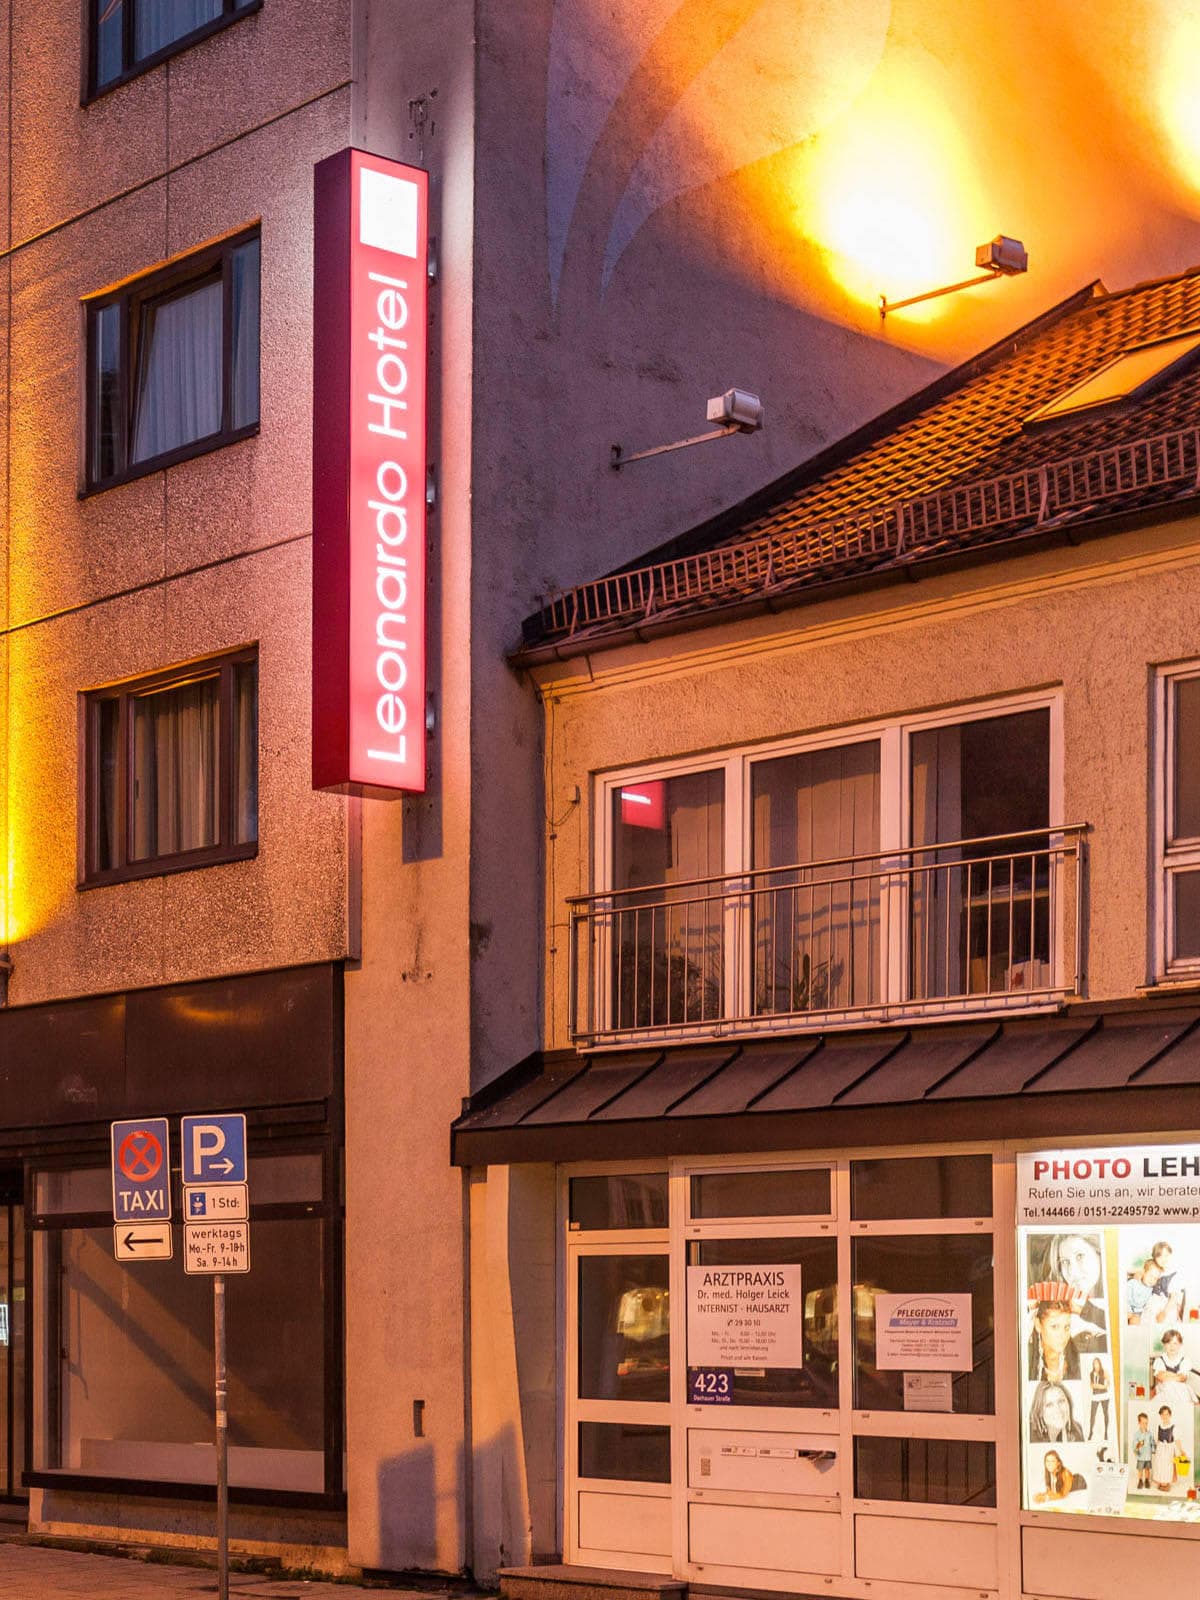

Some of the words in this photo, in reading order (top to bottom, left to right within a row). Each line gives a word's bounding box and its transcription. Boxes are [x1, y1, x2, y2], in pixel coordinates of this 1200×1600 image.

[367, 272, 409, 439] Hotel
[367, 461, 409, 765] Leonardo
[193, 1126, 226, 1176] P
[1034, 1158, 1132, 1181] PHOTO
[1028, 1187, 1063, 1199] Rufen
[1067, 1187, 1086, 1198] Sie
[1089, 1188, 1110, 1199] uns
[1114, 1188, 1133, 1199] an,
[1137, 1186, 1155, 1197] wir
[119, 1189, 164, 1212] TAXI
[1083, 1205, 1160, 1217] 0151-22495792
[191, 1229, 242, 1241] werktags
[196, 1257, 209, 1268] Sa.
[703, 1271, 785, 1287] ARZTPRAXIS
[697, 1290, 710, 1299] Dr.
[712, 1290, 733, 1299] med.
[736, 1289, 765, 1301] Holger
[767, 1289, 790, 1299] Leick
[697, 1304, 738, 1313] INTERNIST
[746, 1303, 790, 1313] HAUSARZT
[897, 1309, 955, 1317] PFLEGEDIENST
[695, 1373, 729, 1393] 423
